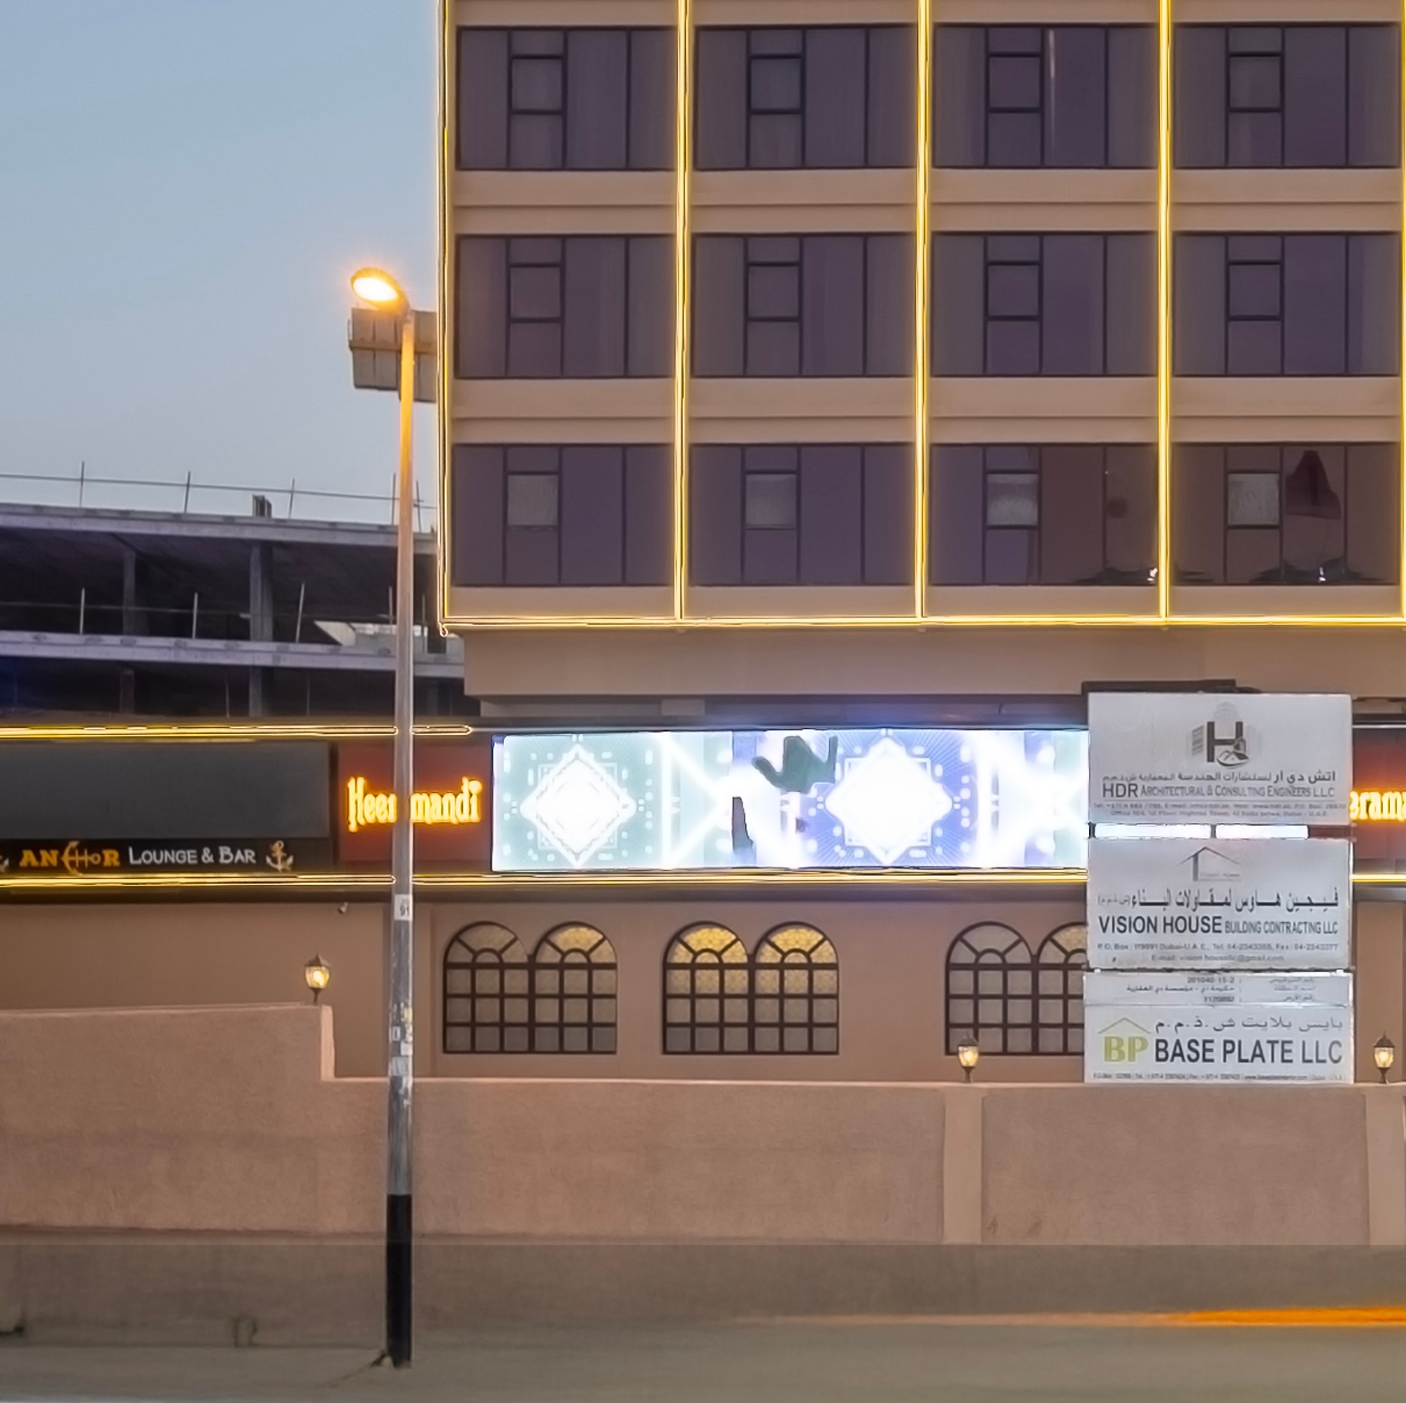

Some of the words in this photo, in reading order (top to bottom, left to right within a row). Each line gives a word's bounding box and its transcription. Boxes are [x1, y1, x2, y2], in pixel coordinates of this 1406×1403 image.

[1102, 783, 1138, 798] HDR
[347, 776, 482, 833] Heermandi
[201, 848, 214, 864] &
[1098, 915, 1158, 934] VISION
[1162, 915, 1223, 934] HOUSE
[1323, 921, 1339, 934] LLC
[1104, 1036, 1149, 1063] BP
[1155, 1038, 1215, 1064] BASE
[1223, 1039, 1294, 1064] PLATE
[1302, 1039, 1343, 1064] LLC
